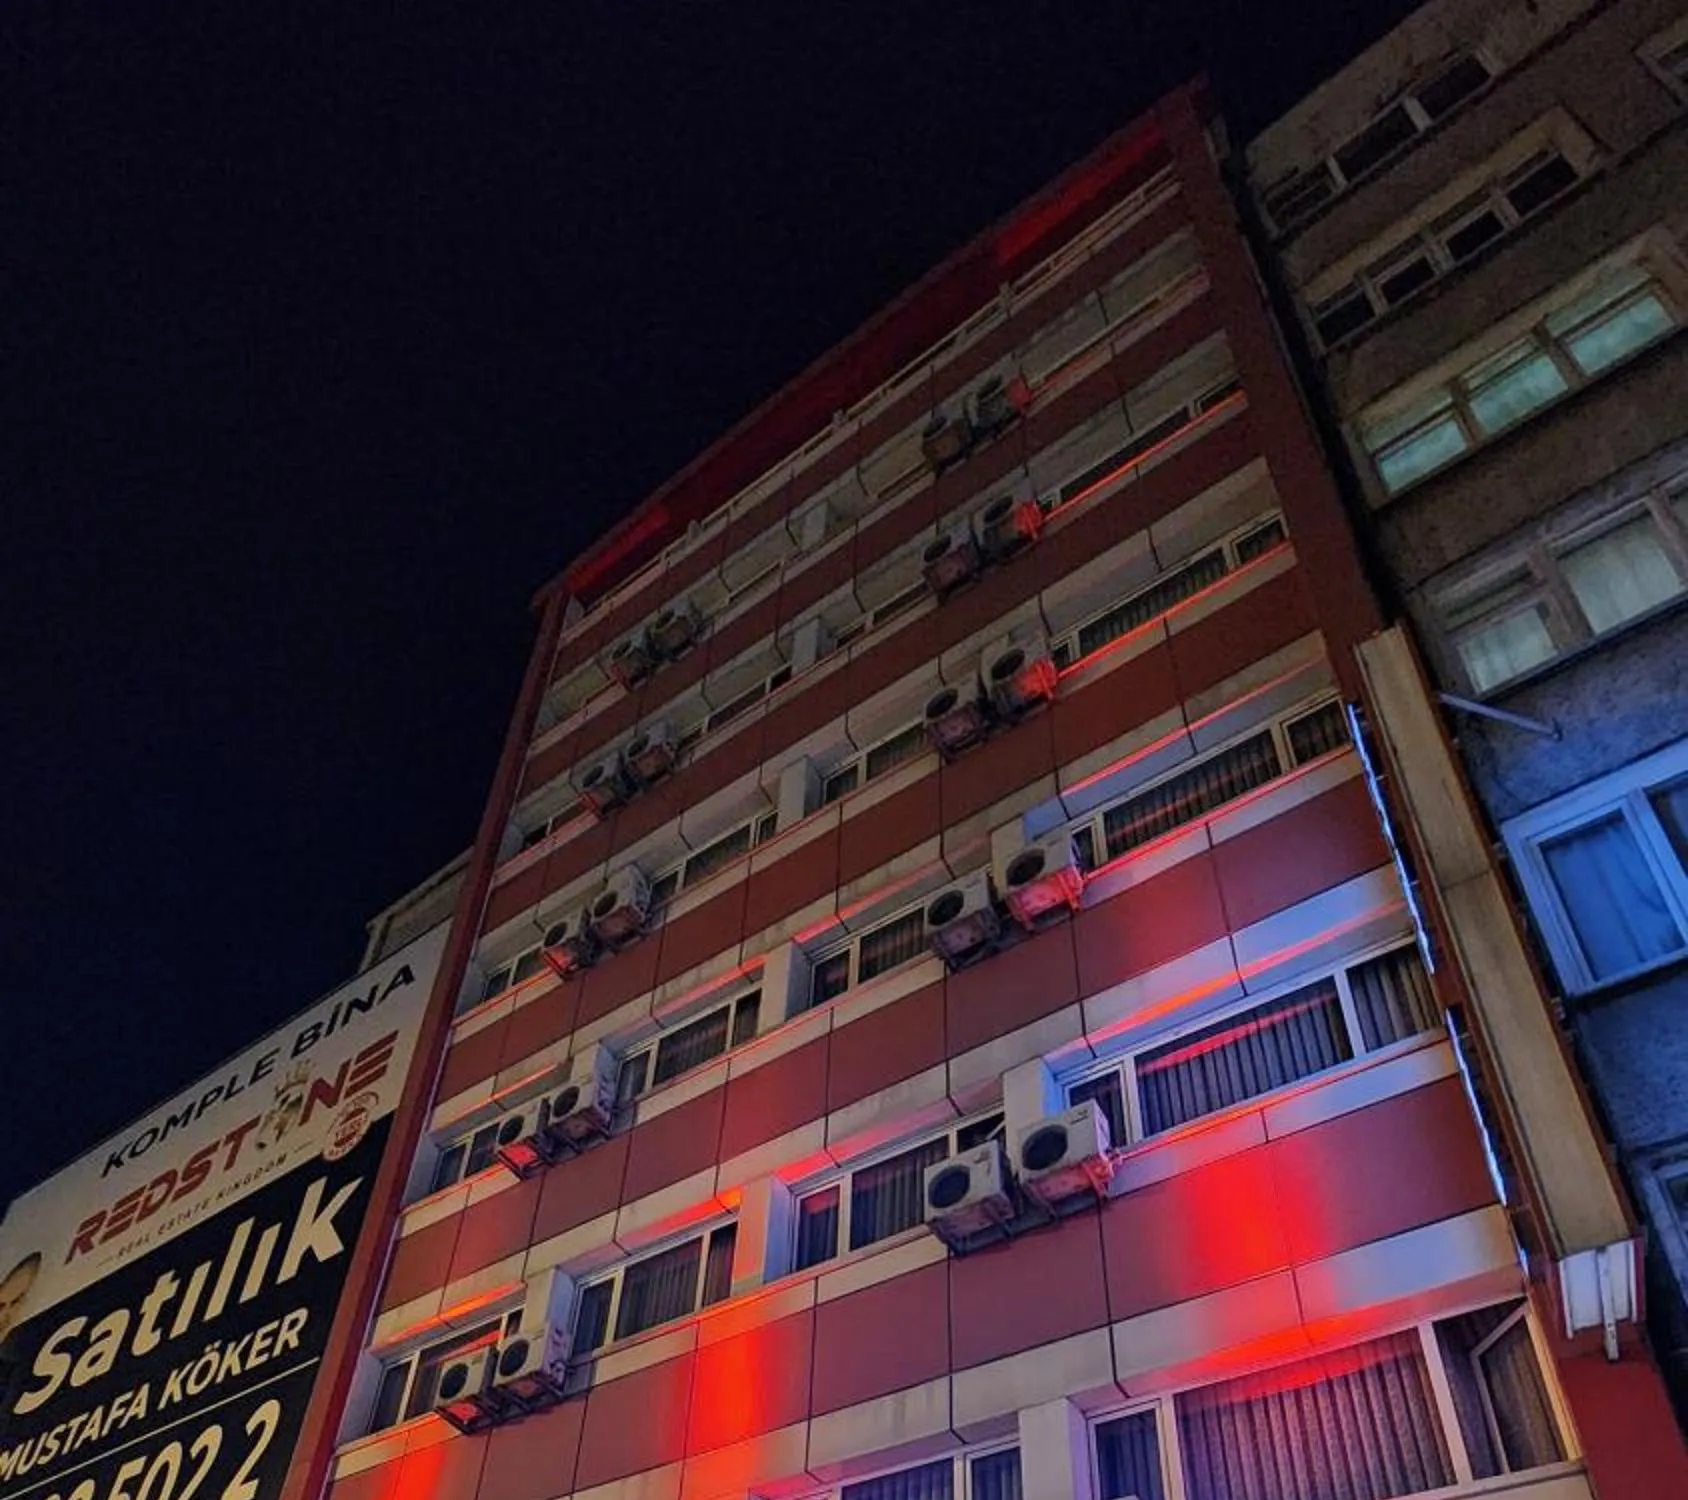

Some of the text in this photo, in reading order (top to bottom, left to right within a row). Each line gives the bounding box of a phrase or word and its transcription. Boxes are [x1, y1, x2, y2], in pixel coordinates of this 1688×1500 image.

[64, 1029, 399, 1265] REDSTNE
[101, 1046, 281, 1179] KOMPLE
[0, 1306, 309, 1482] MUSTAFA KÖKER
[13, 1176, 364, 1415] Satılık
